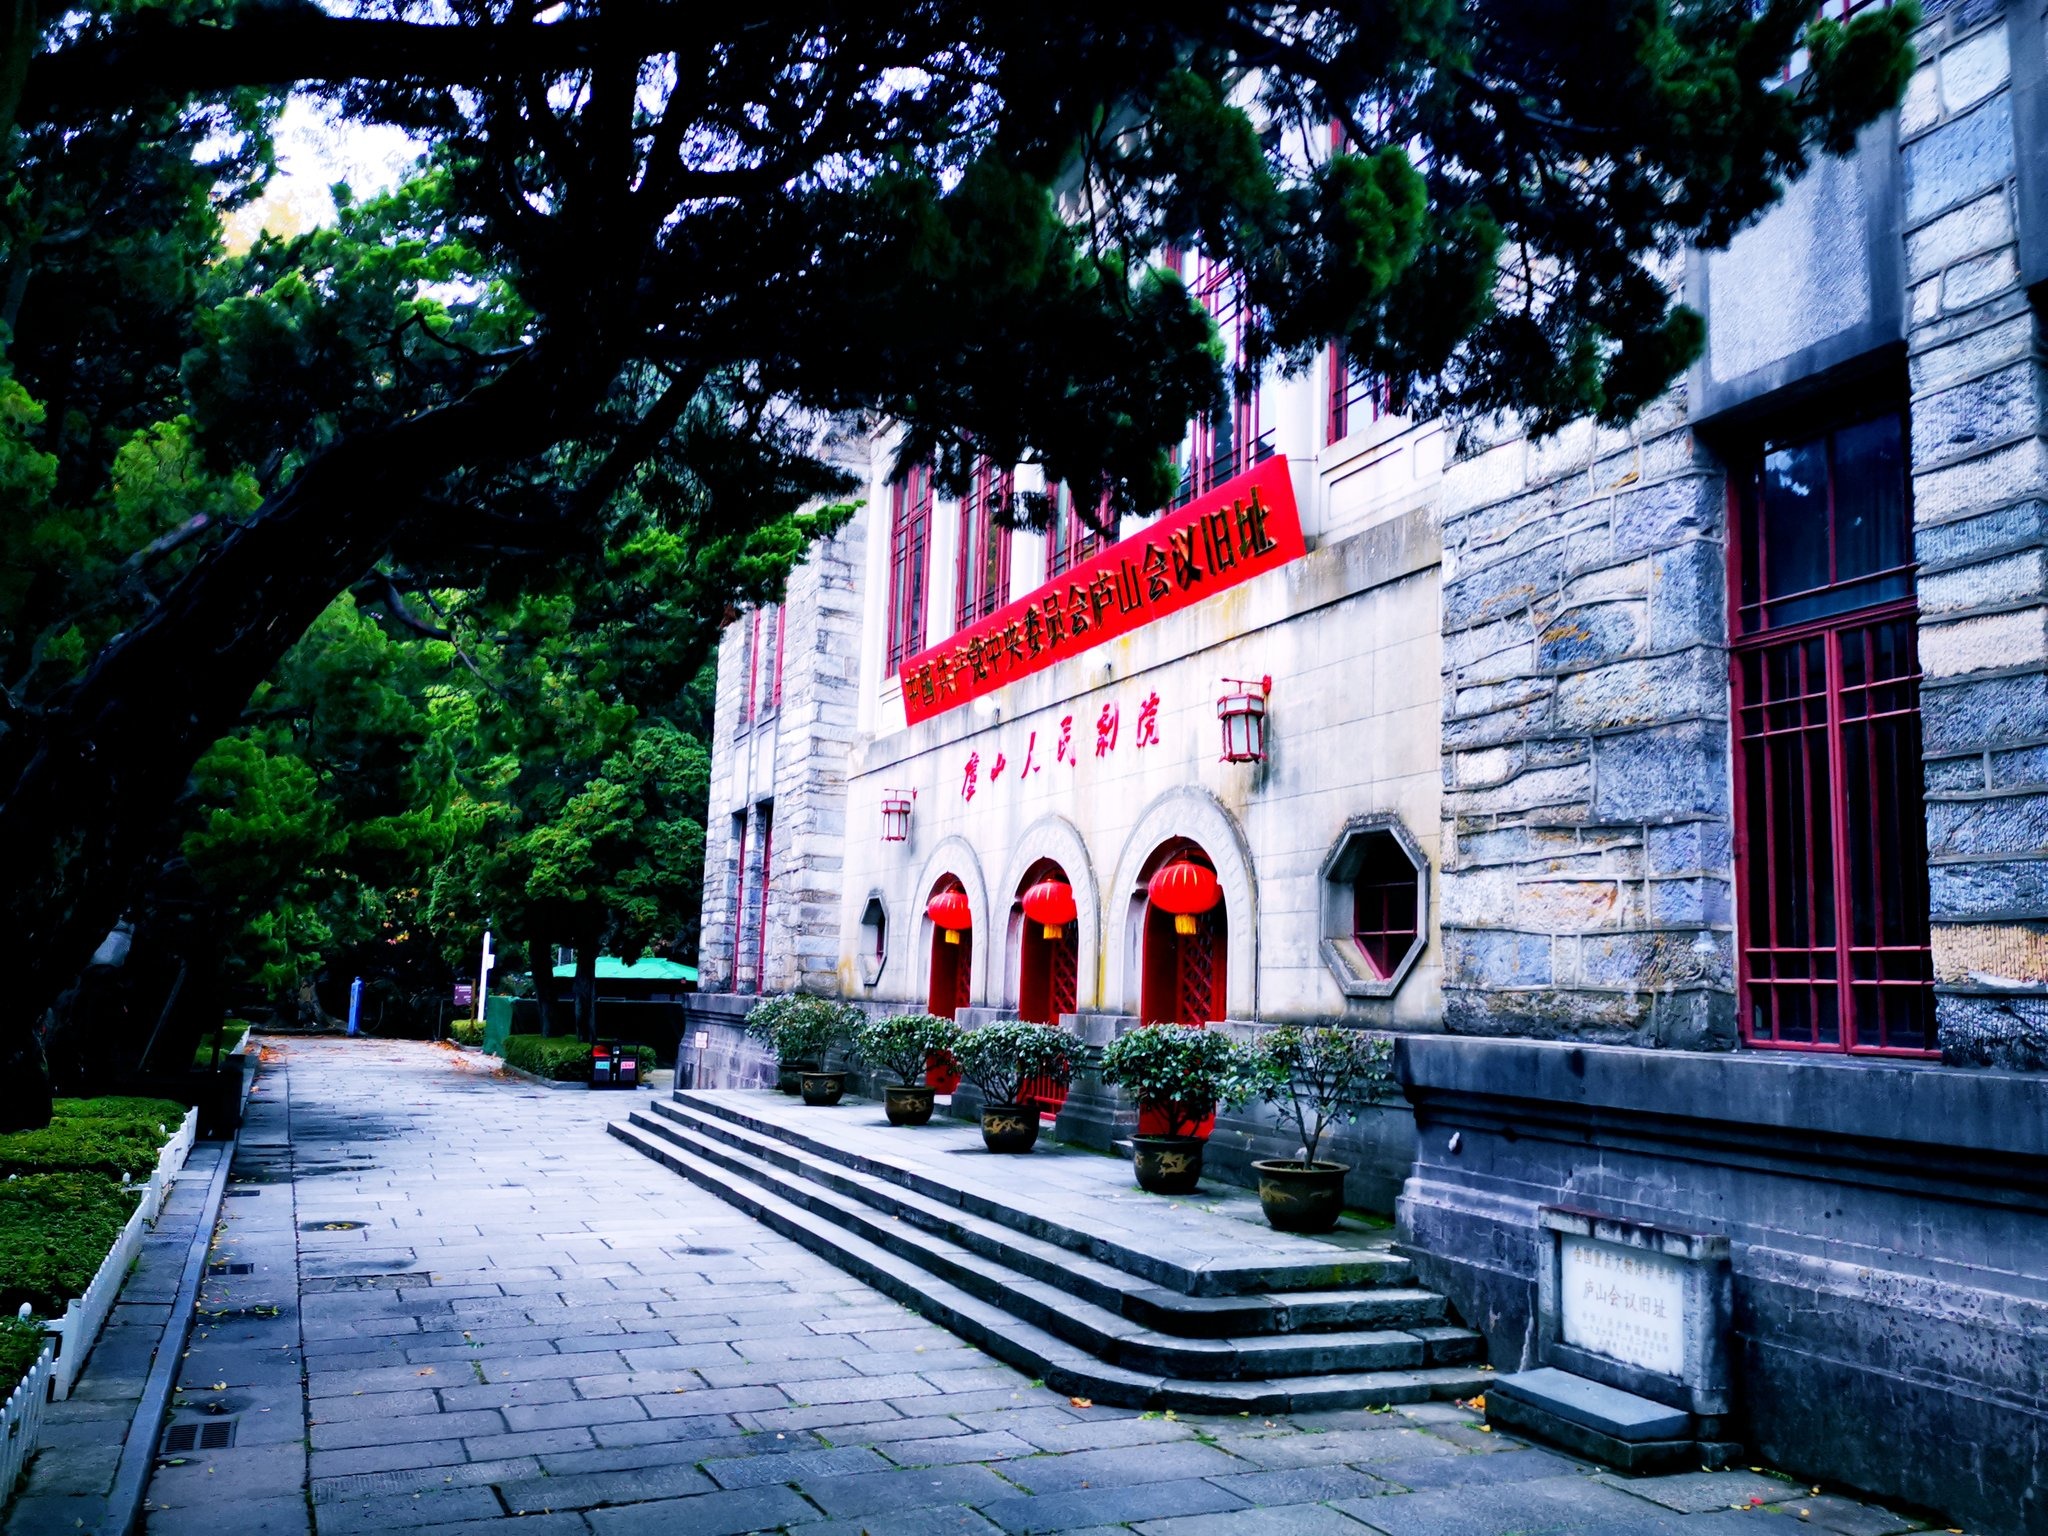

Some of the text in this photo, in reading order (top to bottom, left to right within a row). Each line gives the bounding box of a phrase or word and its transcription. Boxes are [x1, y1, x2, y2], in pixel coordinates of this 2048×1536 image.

[905, 485, 1278, 712] 中国共产党中央委员会庐山会议旧址
[1583, 1279, 1668, 1319] 庐山会议旧址
